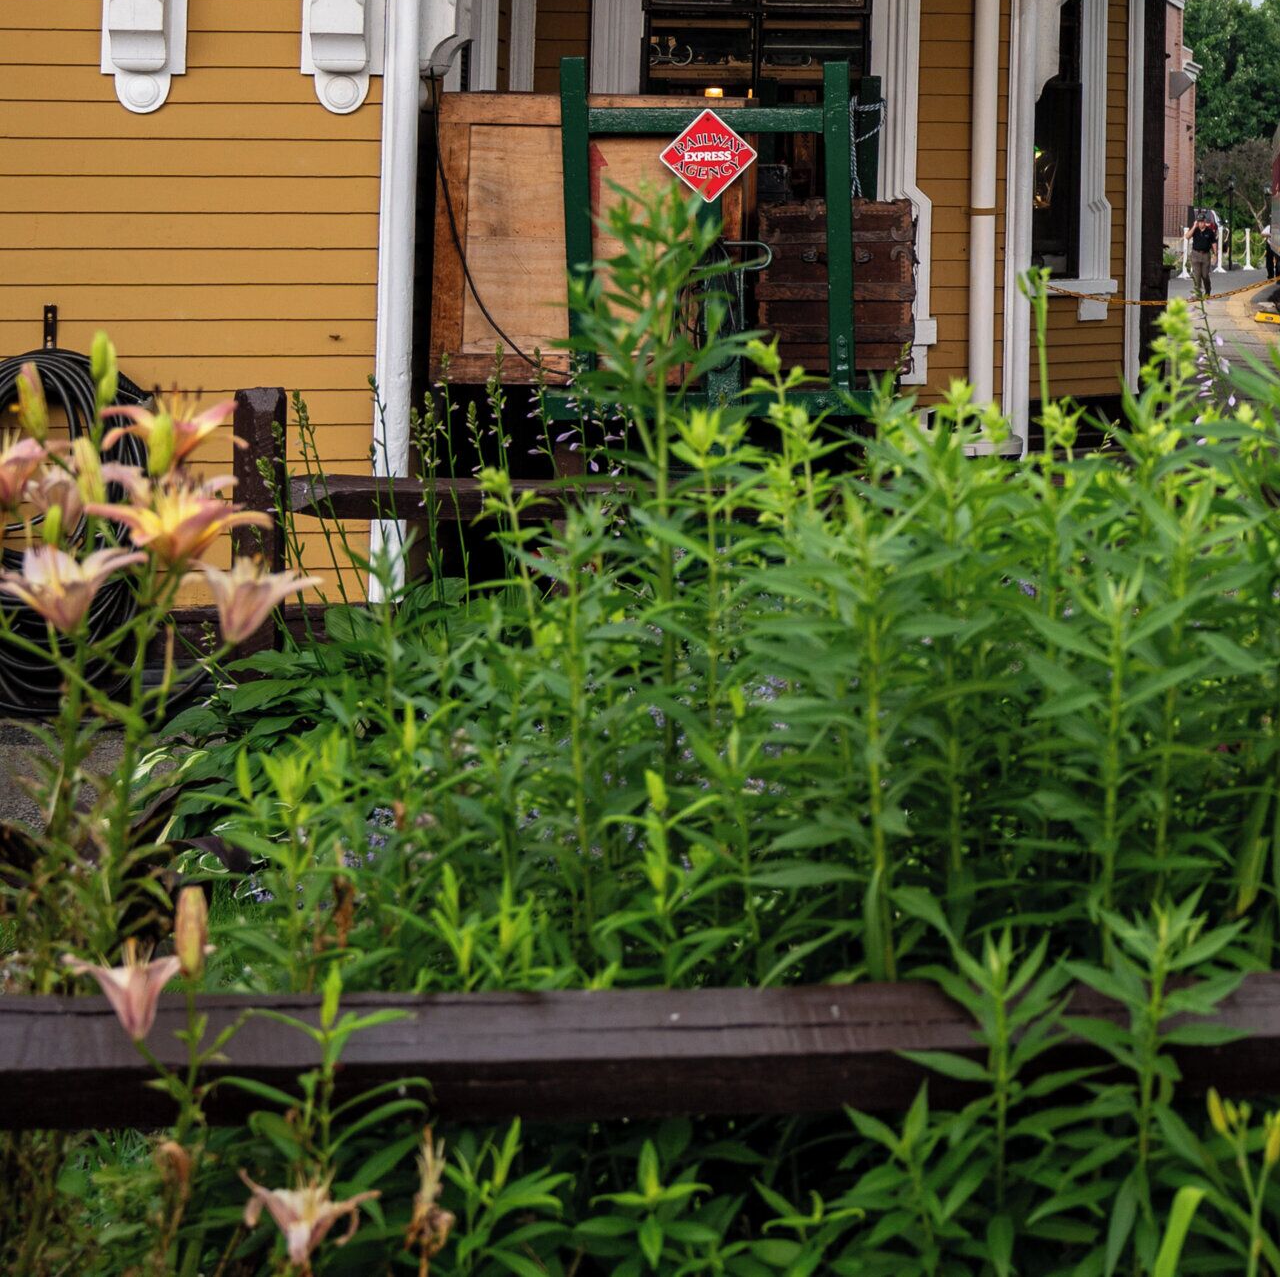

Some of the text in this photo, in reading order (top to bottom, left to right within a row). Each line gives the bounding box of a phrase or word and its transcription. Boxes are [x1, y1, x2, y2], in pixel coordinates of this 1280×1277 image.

[672, 132, 748, 155] RAILWAY
[672, 156, 740, 179] AGENCY
[684, 150, 732, 162] EXPRESS
